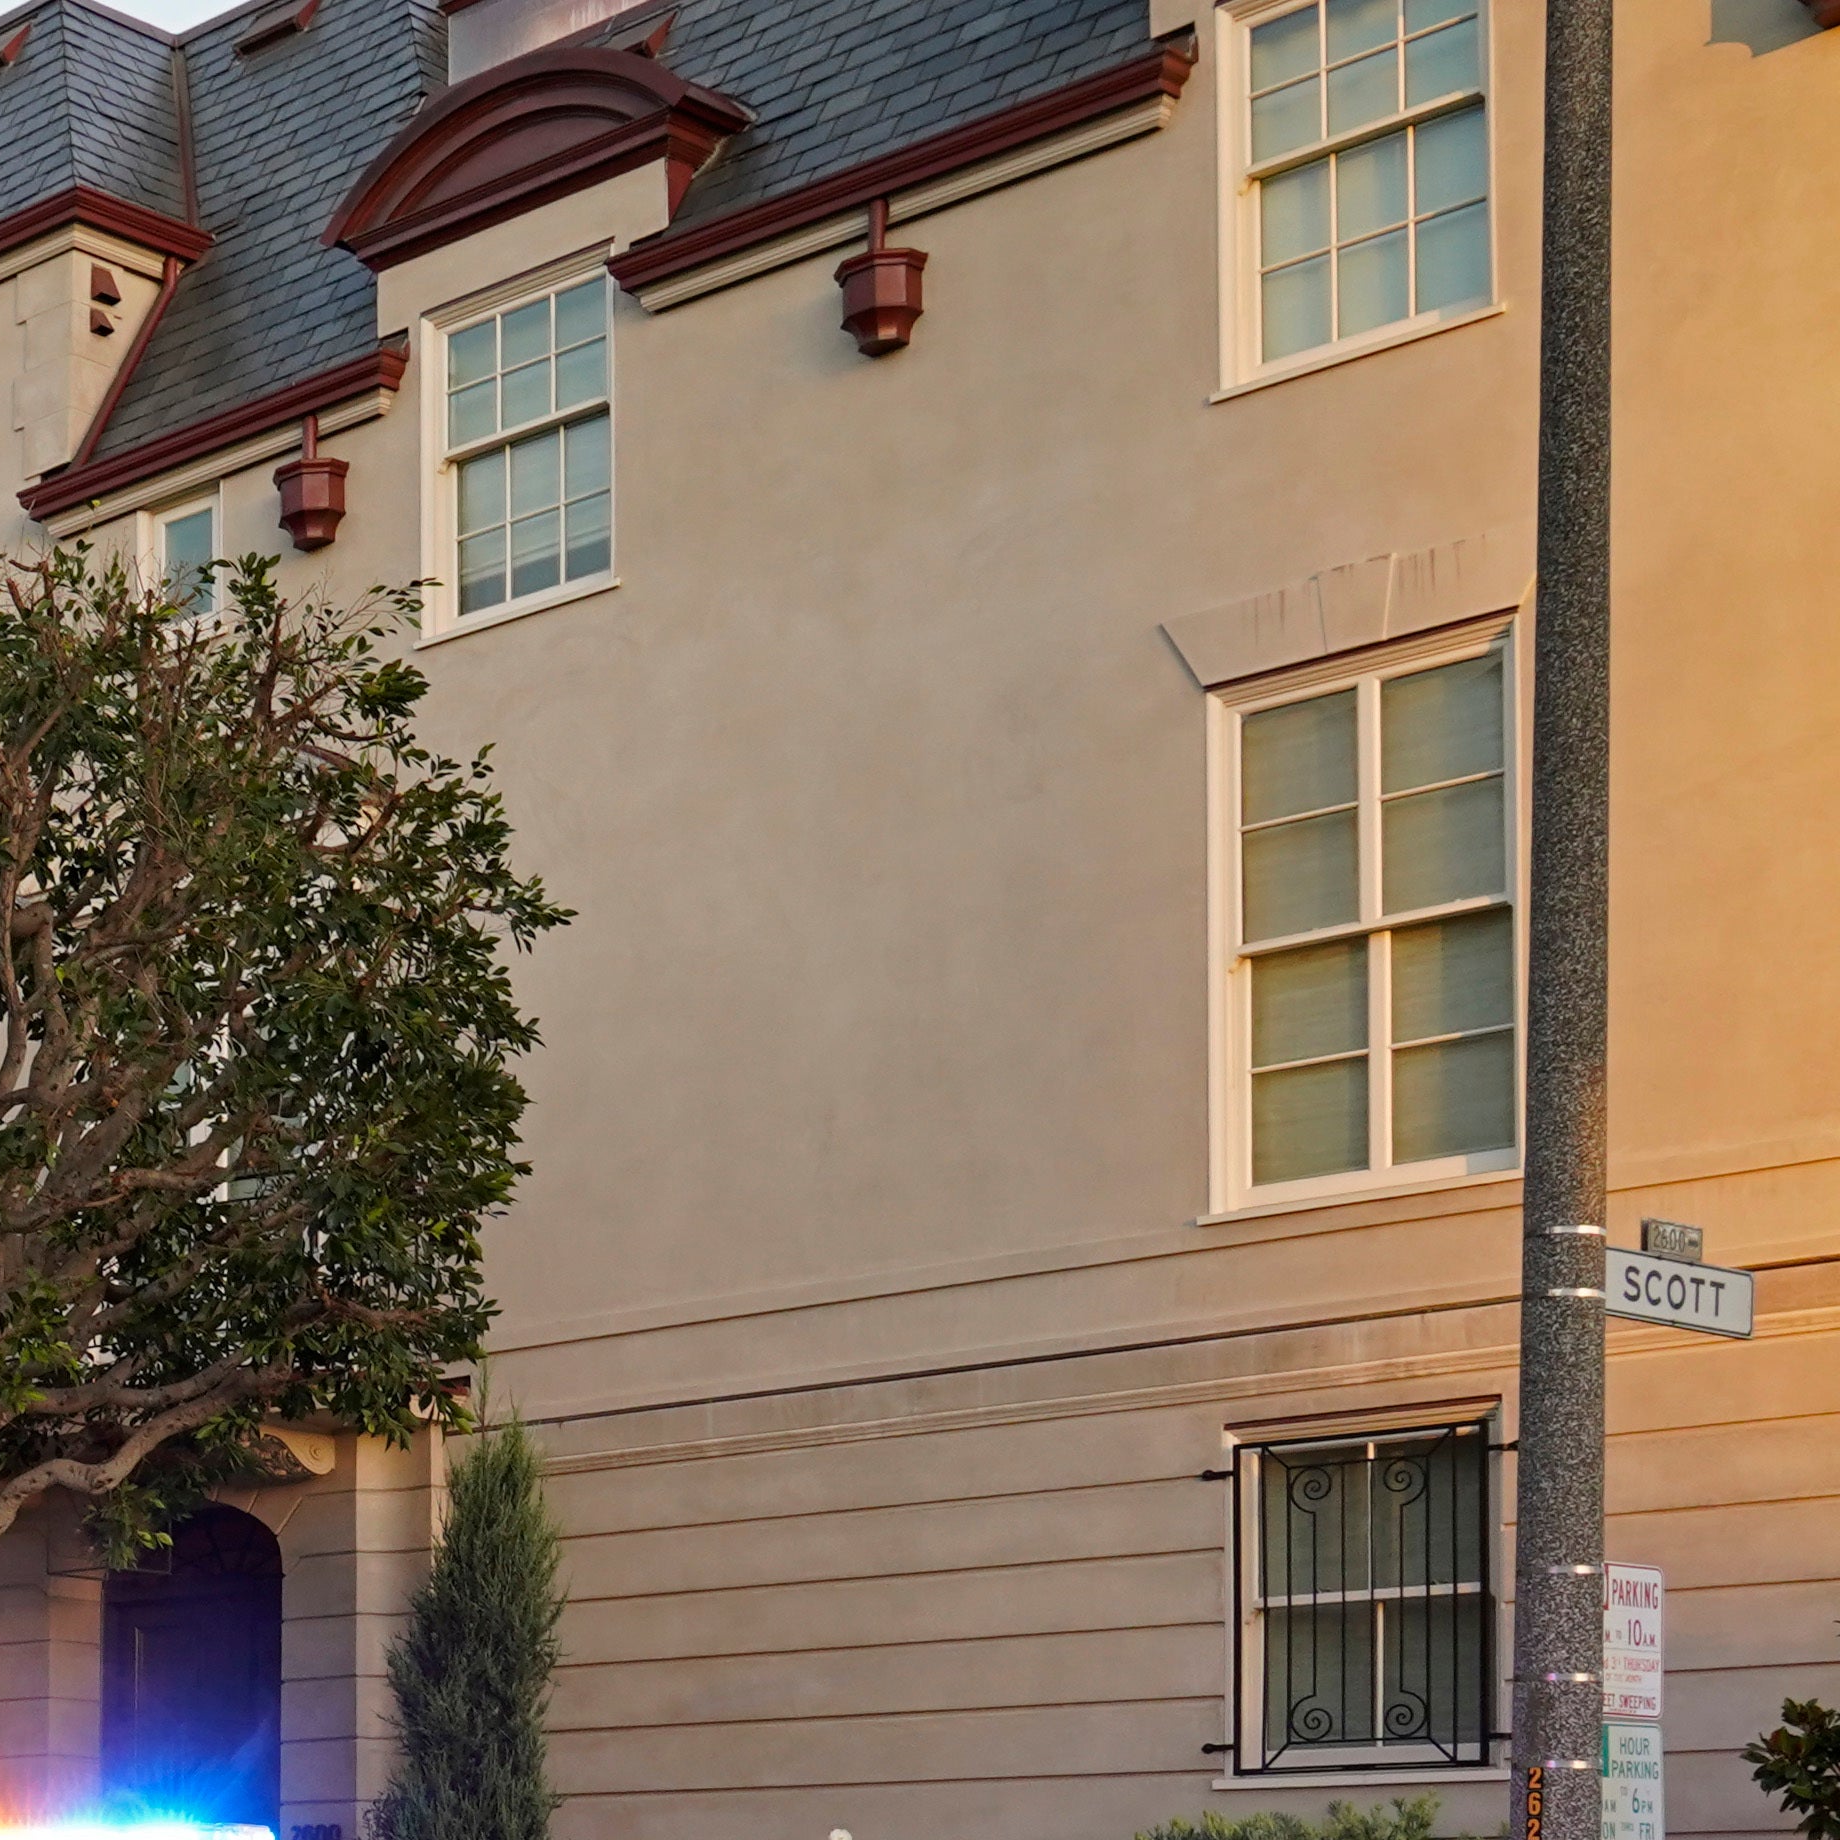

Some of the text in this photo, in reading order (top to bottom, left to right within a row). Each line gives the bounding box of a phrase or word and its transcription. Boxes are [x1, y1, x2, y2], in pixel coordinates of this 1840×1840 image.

[1653, 1224, 1686, 1253] 2600
[1623, 1265, 1726, 1318] SCOTT
[1612, 1578, 1659, 1610] PARKING
[1619, 1694, 1657, 1711] SWEEPING
[1619, 1736, 1651, 1755] HOUR
[1611, 1759, 1660, 1780] PARKING
[1604, 1798, 1617, 1813] AM
[1602, 1822, 1616, 1840] ON
[1639, 1822, 1655, 1840] FRI
